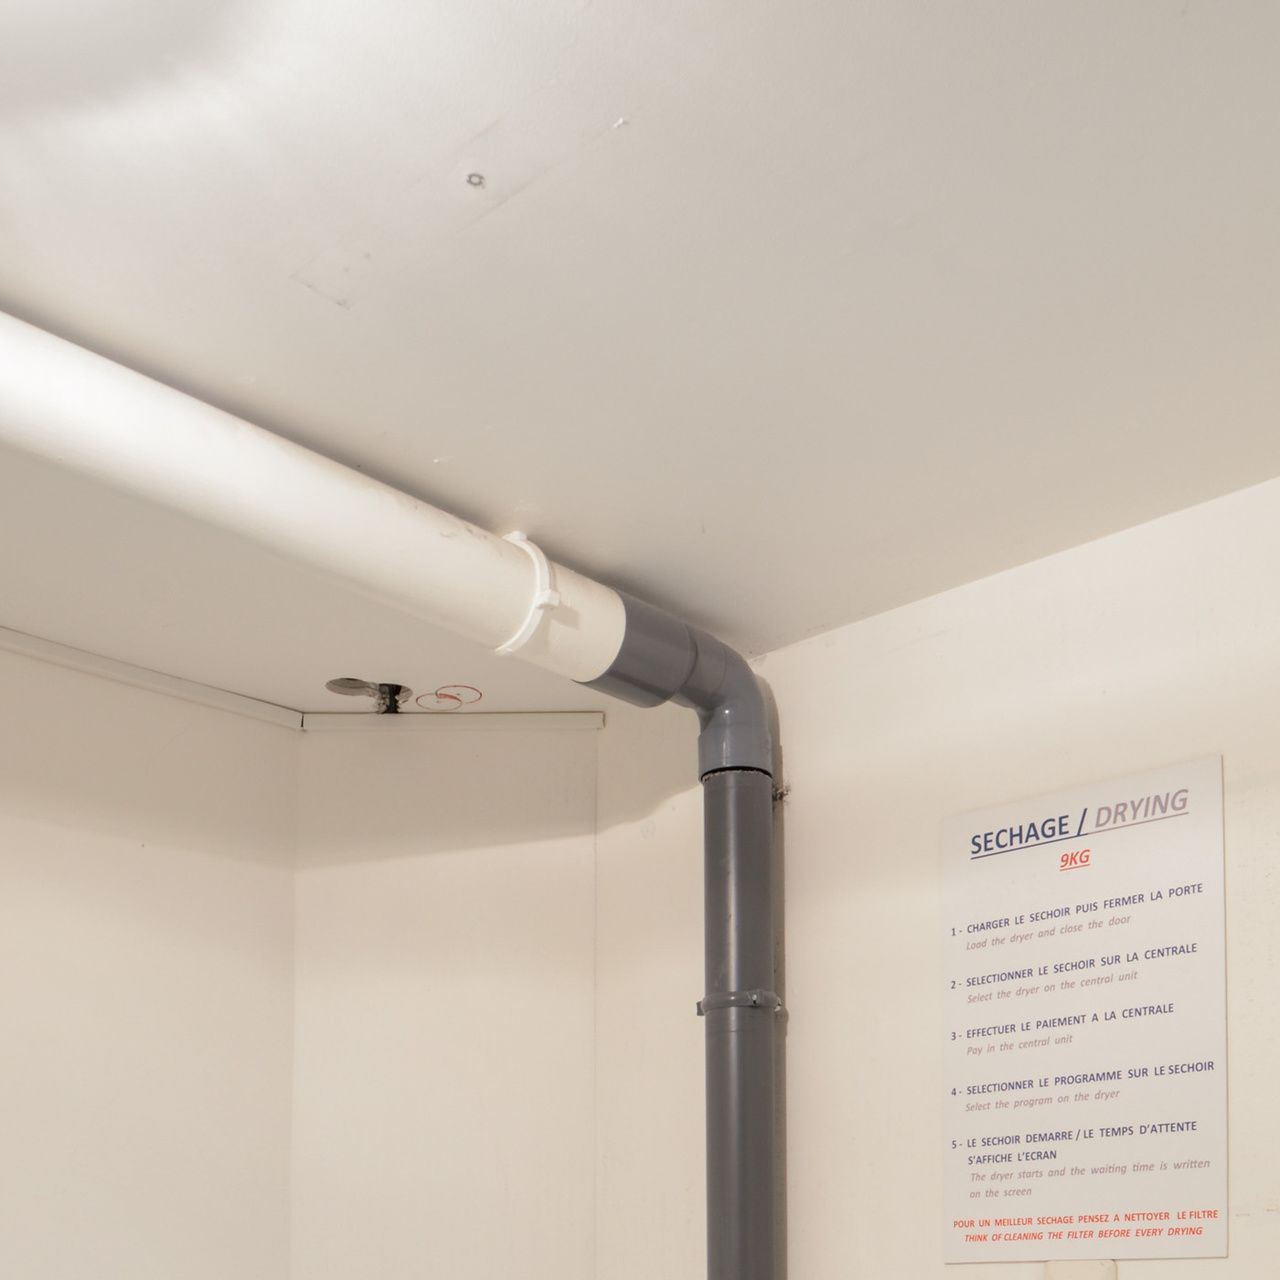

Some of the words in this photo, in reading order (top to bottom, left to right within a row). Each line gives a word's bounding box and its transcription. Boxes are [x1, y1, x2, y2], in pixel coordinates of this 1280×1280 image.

[971, 815, 1069, 854] SECHAGE
[1075, 808, 1088, 836] /
[1096, 790, 1188, 827] DRYING
[1060, 849, 1090, 868] 9KG
[967, 918, 1010, 933] CHARGER
[1015, 915, 1024, 925] LE
[1030, 907, 1070, 922] SECHOIR
[1076, 902, 1098, 914] PUIS
[1104, 894, 1144, 909] FERMER
[1150, 891, 1163, 901] LA
[1169, 883, 1203, 898] PORTE
[966, 968, 1033, 987] SELECTIONNER
[1039, 966, 1048, 976] LE
[1054, 959, 1095, 973] SECHOIR
[1101, 955, 1120, 966] SUR
[1127, 952, 1139, 962] LA
[1144, 943, 1197, 959] CENTRALE
[967, 1024, 1016, 1038] EFFECTUER
[1021, 1022, 1031, 1031] LE
[1036, 1015, 1086, 1029] PAIEMENT
[1092, 1013, 1099, 1022] A
[1105, 1011, 1116, 1021] LA
[1122, 1003, 1174, 1018] CENTRALE
[966, 1080, 1034, 1095] SELECTIONNER
[1039, 1078, 1049, 1087] LE
[1055, 1070, 1122, 1086] PROGRAMME
[1128, 1068, 1148, 1078] SUR
[1154, 1066, 1165, 1076] LE
[1168, 1061, 1214, 1075] SECHOIR
[967, 1138, 977, 1148] LE
[981, 1135, 1021, 1148] SECHOIR
[1026, 1131, 1073, 1144] DEMARRE
[1084, 1129, 1094, 1139] LE
[1099, 1126, 1134, 1137] TEMPS
[1140, 1121, 1198, 1134] D'ATTENTE
[968, 1153, 1012, 1165] S'AFFICHE
[1018, 1150, 1057, 1161] L'ECRAN
